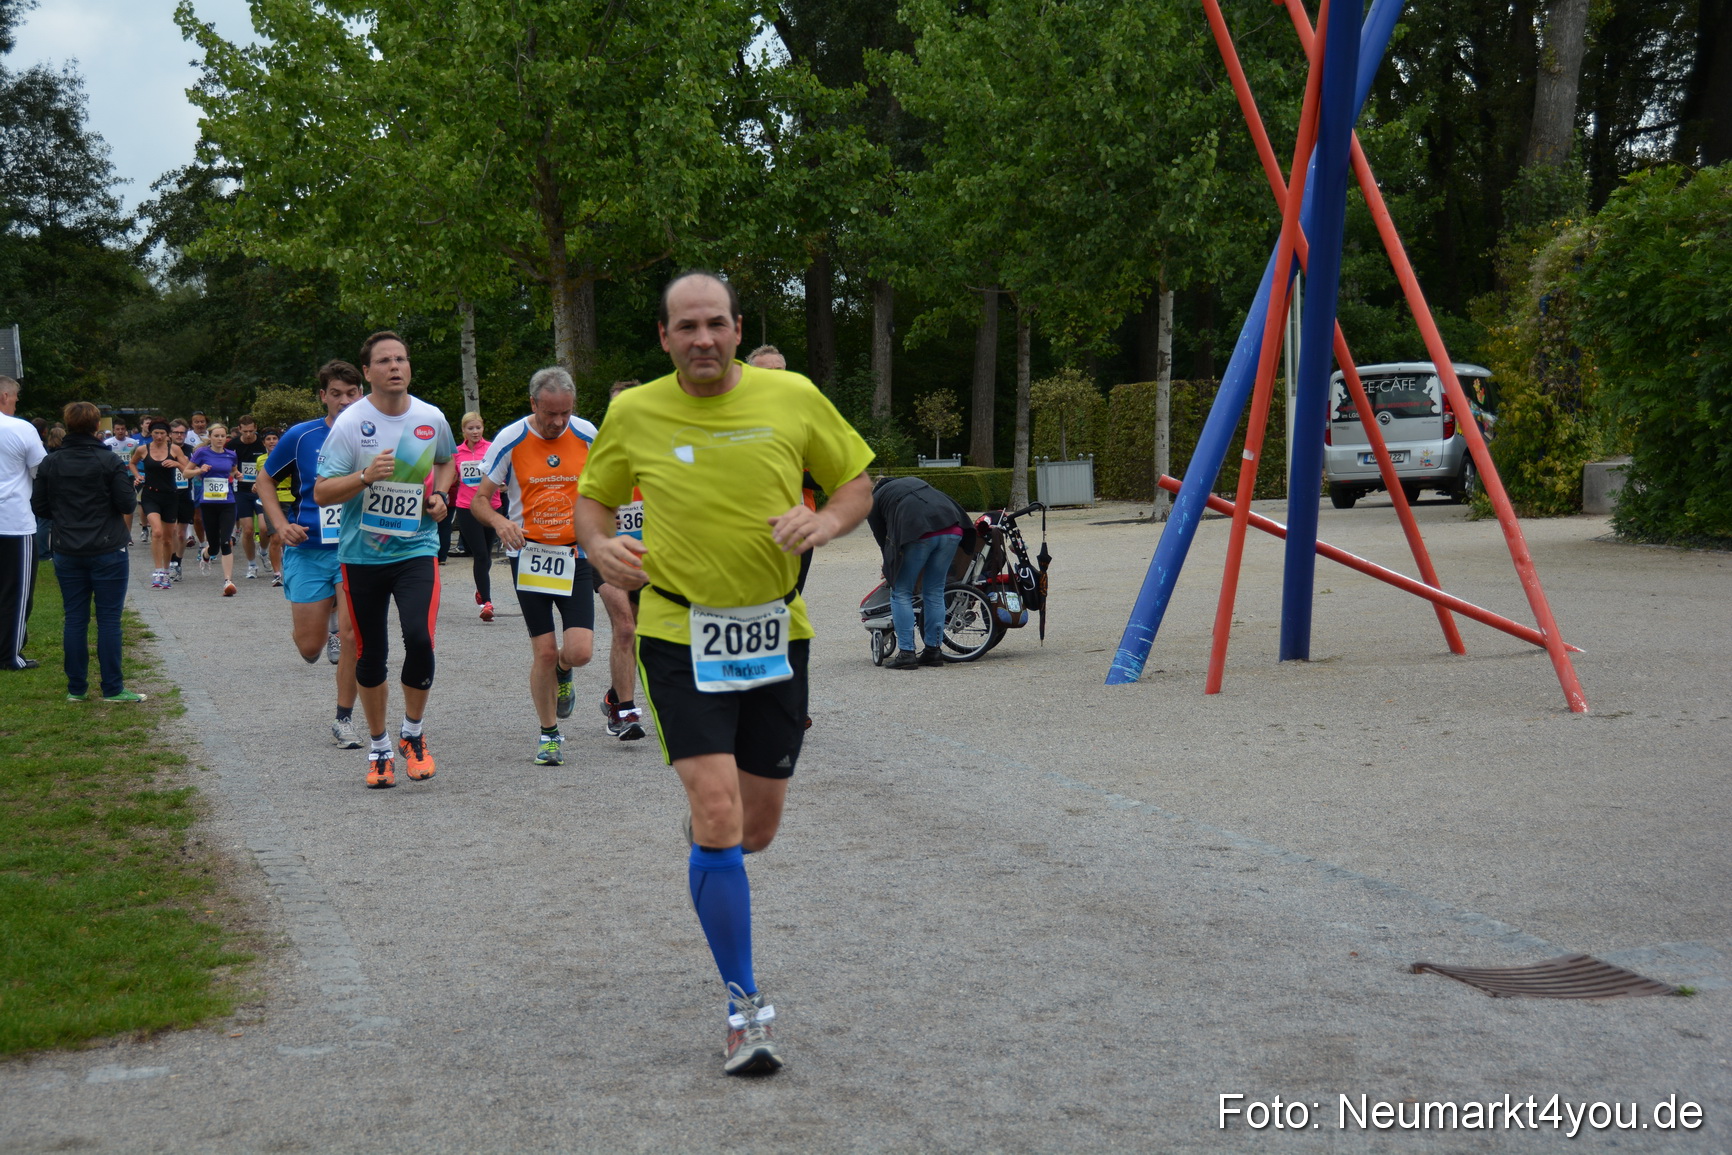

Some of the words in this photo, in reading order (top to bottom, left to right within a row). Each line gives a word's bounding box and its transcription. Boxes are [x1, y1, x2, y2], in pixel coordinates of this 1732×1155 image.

[529, 474, 578, 484] SportScheck
[209, 483, 224, 492] 362
[386, 486, 414, 494] Neumarkt
[368, 493, 418, 517] 2082
[379, 518, 402, 529] David
[533, 517, 571, 526] Nürnberg
[541, 548, 568, 557] Neumarkt
[530, 554, 565, 576] 540
[702, 619, 781, 656] 2089
[722, 663, 767, 678] Markus
